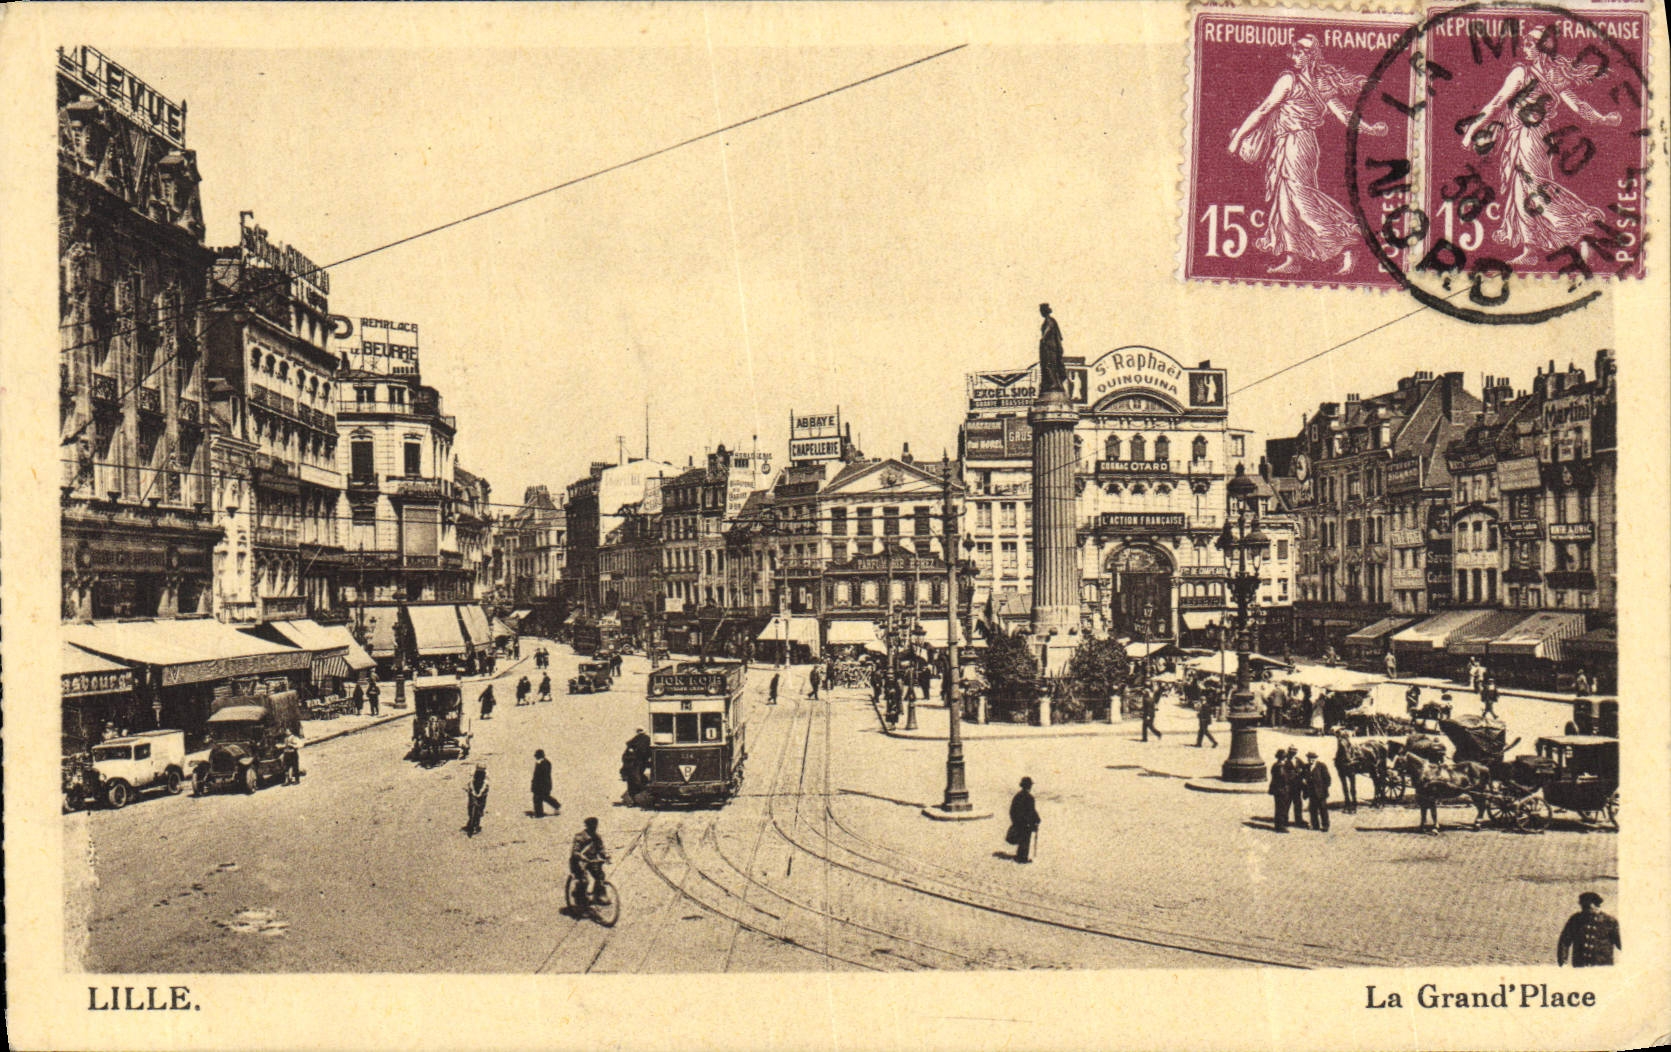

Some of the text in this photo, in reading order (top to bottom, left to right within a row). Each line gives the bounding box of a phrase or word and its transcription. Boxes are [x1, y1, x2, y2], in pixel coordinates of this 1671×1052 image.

[362, 341, 418, 361] BEURRE
[1112, 352, 1183, 380] Raphaël
[1097, 374, 1178, 395] QUINQUINA
[797, 416, 835, 428] ABBAYE
[792, 442, 839, 457] CHAPELLERIE
[1130, 462, 1168, 471] OTARD
[1103, 515, 1184, 527] L'ACTION FRANÇAISE
